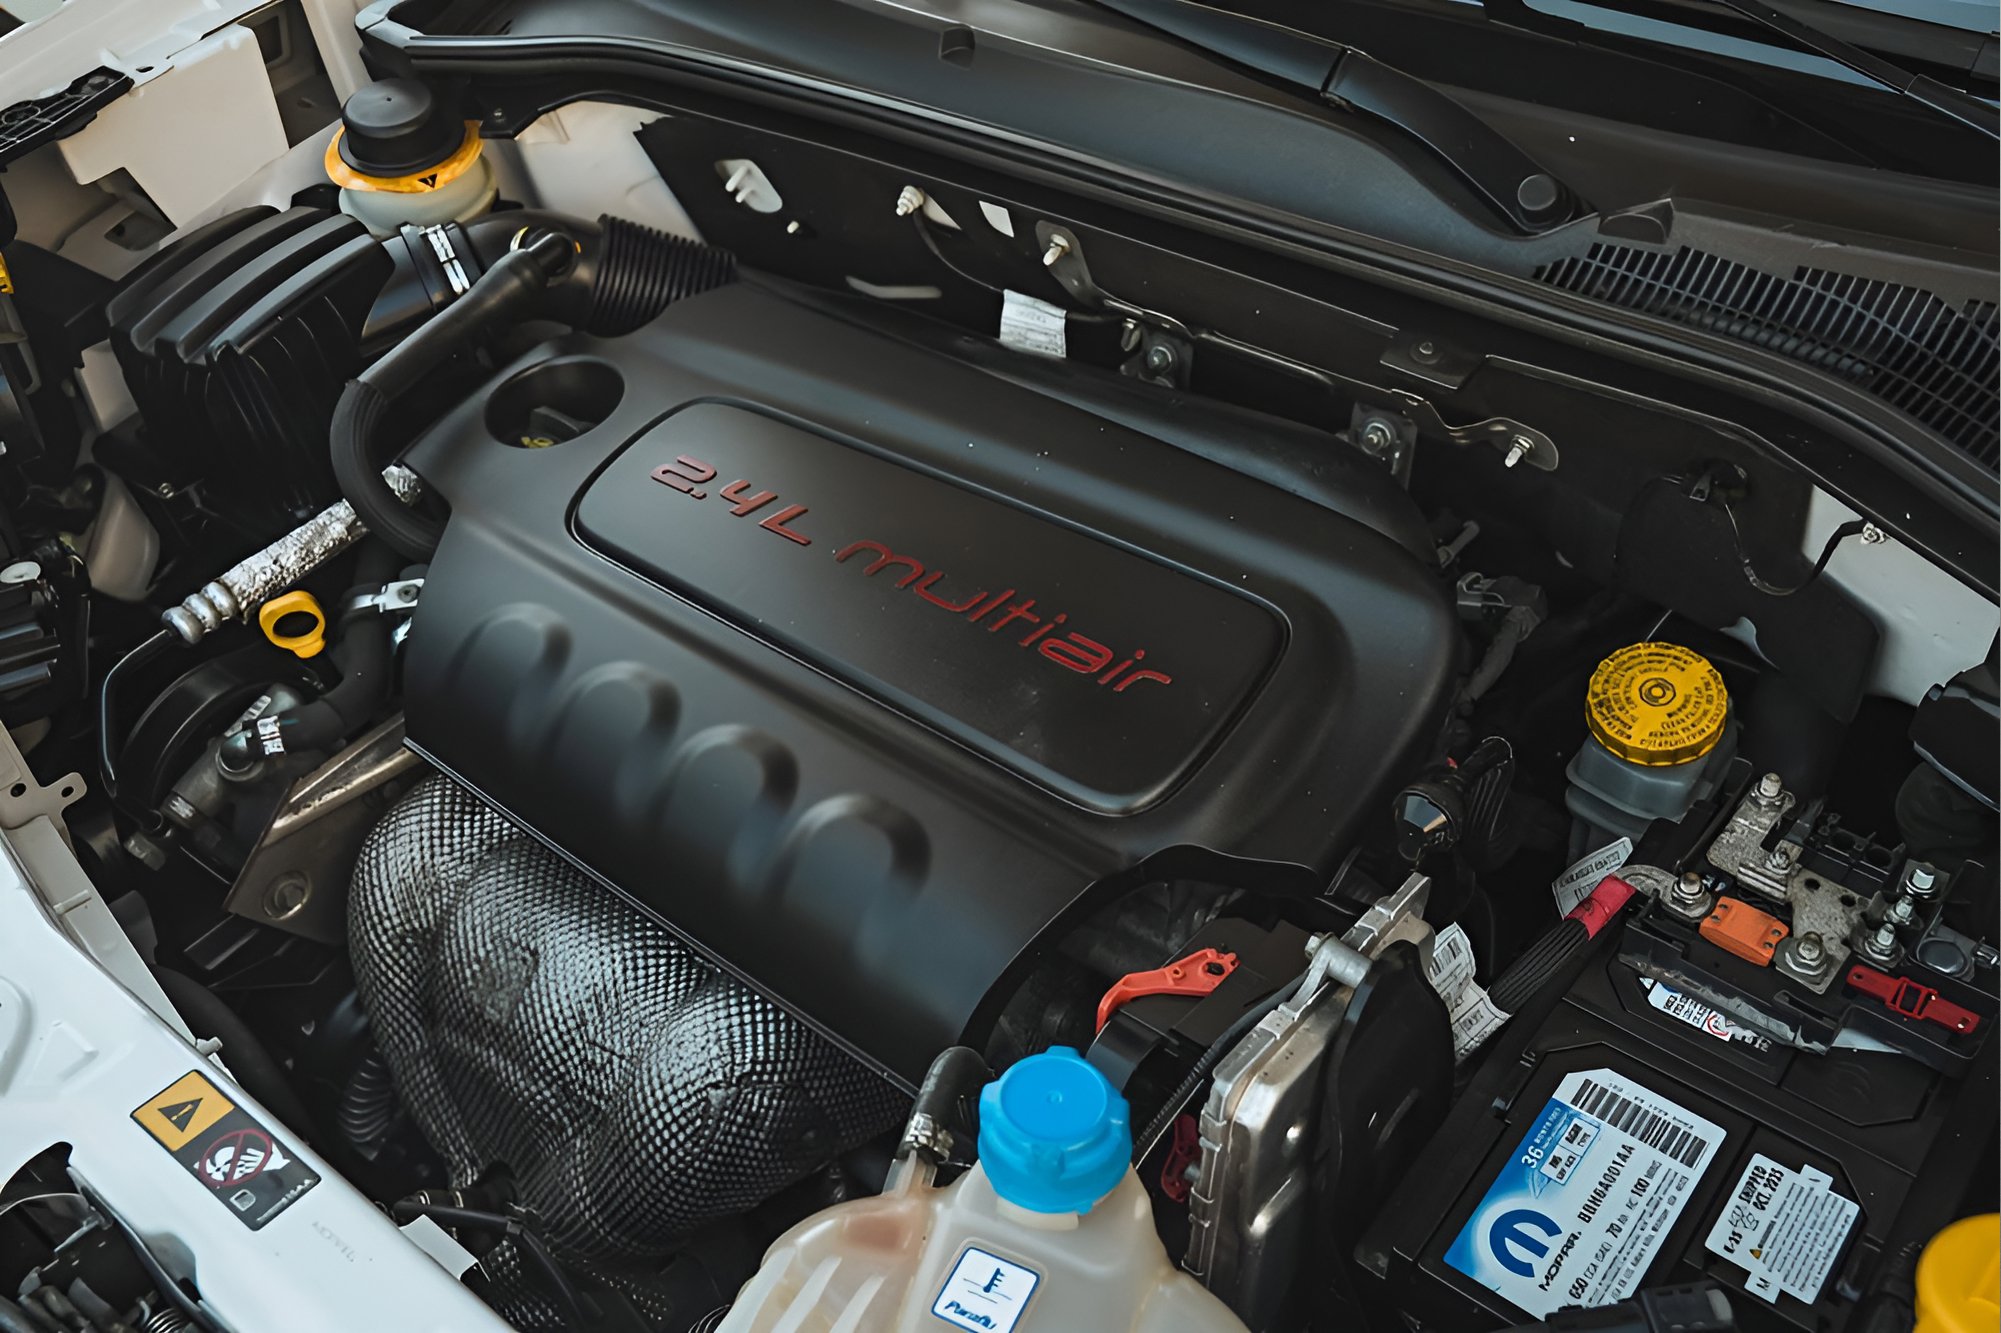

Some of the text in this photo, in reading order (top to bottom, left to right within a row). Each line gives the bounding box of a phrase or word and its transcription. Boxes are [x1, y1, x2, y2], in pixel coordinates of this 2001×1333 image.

[651, 455, 1173, 692] 2.4L multiair
[1522, 1146, 1543, 1171] 36
